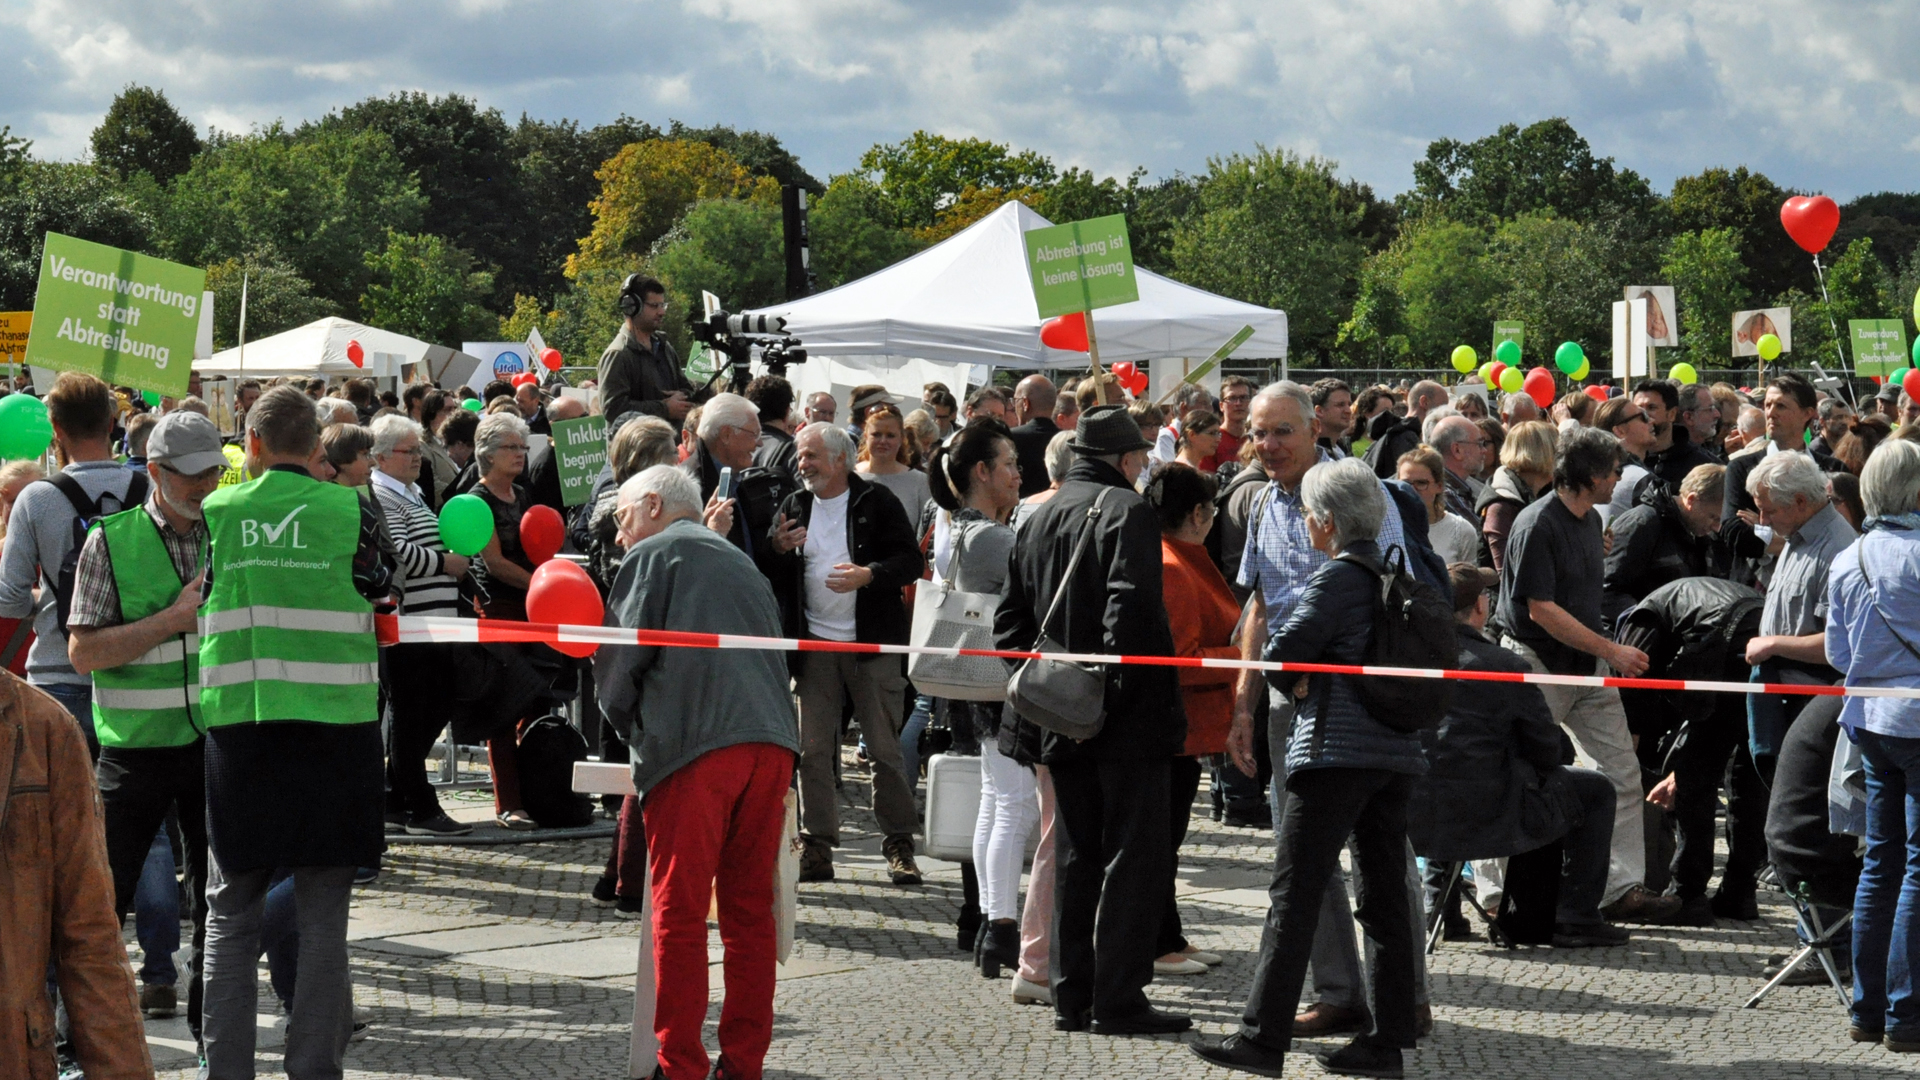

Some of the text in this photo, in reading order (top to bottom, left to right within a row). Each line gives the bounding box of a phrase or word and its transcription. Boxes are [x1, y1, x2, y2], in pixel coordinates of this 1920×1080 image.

[1036, 234, 1124, 264] Abtreibung ist
[50, 254, 197, 318] Verantwortung
[1042, 261, 1125, 286] keine Lösung
[97, 301, 141, 327] statt
[56, 316, 170, 370] Abtreibung
[1857, 328, 1899, 340] Zuwendung
[563, 475, 583, 489] vor
[223, 556, 330, 572] Bundesverband Lebensrecht
